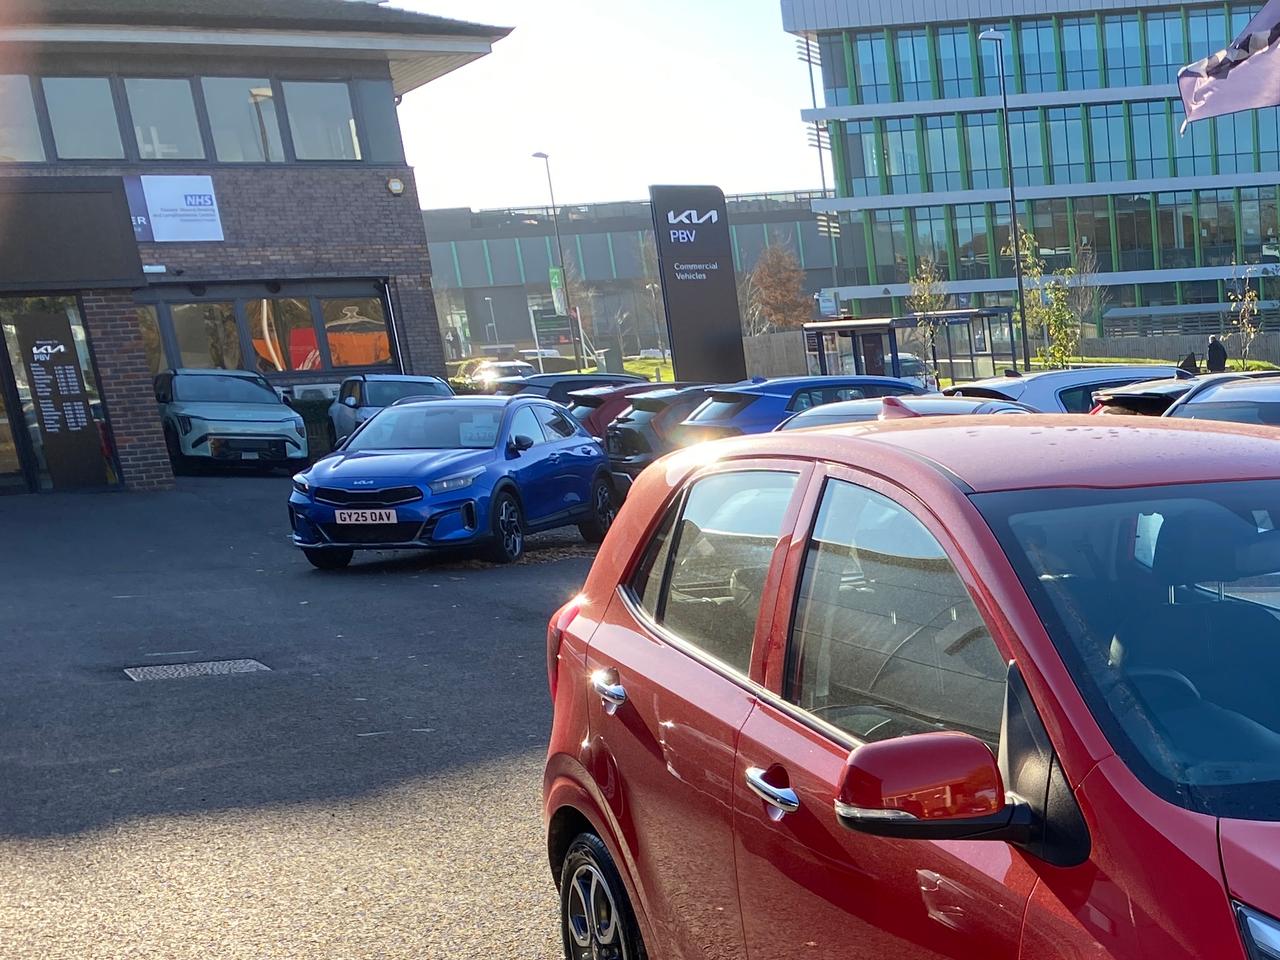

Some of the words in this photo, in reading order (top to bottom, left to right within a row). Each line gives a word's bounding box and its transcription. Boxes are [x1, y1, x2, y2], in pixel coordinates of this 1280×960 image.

[186, 194, 212, 206] NHS
[667, 209, 718, 224] KIA
[670, 229, 696, 243] PBV
[674, 262, 718, 271] Commercial
[676, 272, 706, 280] Vehicles
[339, 511, 368, 522] GY25
[370, 511, 391, 522] OAV
